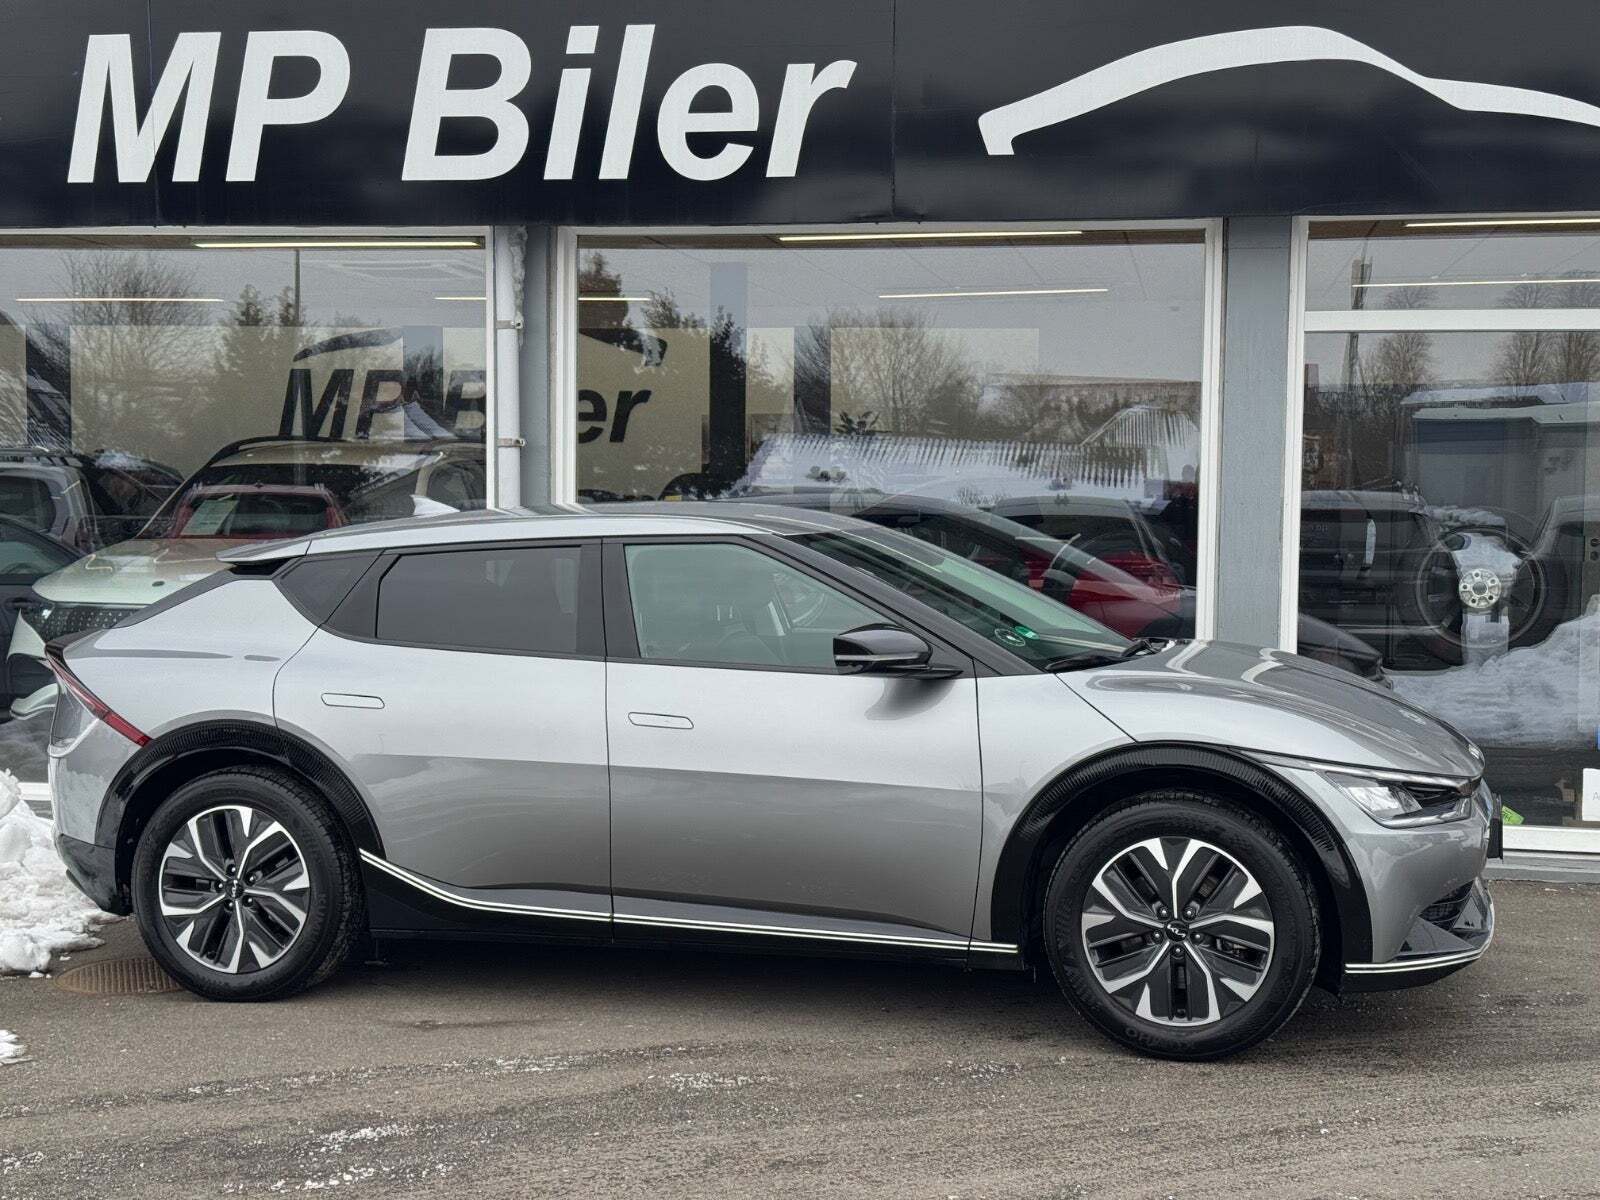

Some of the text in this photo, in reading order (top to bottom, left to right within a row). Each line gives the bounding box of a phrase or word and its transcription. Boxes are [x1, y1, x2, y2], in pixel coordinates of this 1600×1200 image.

[68, 24, 858, 184] MP Biler
[279, 367, 415, 441] MP
